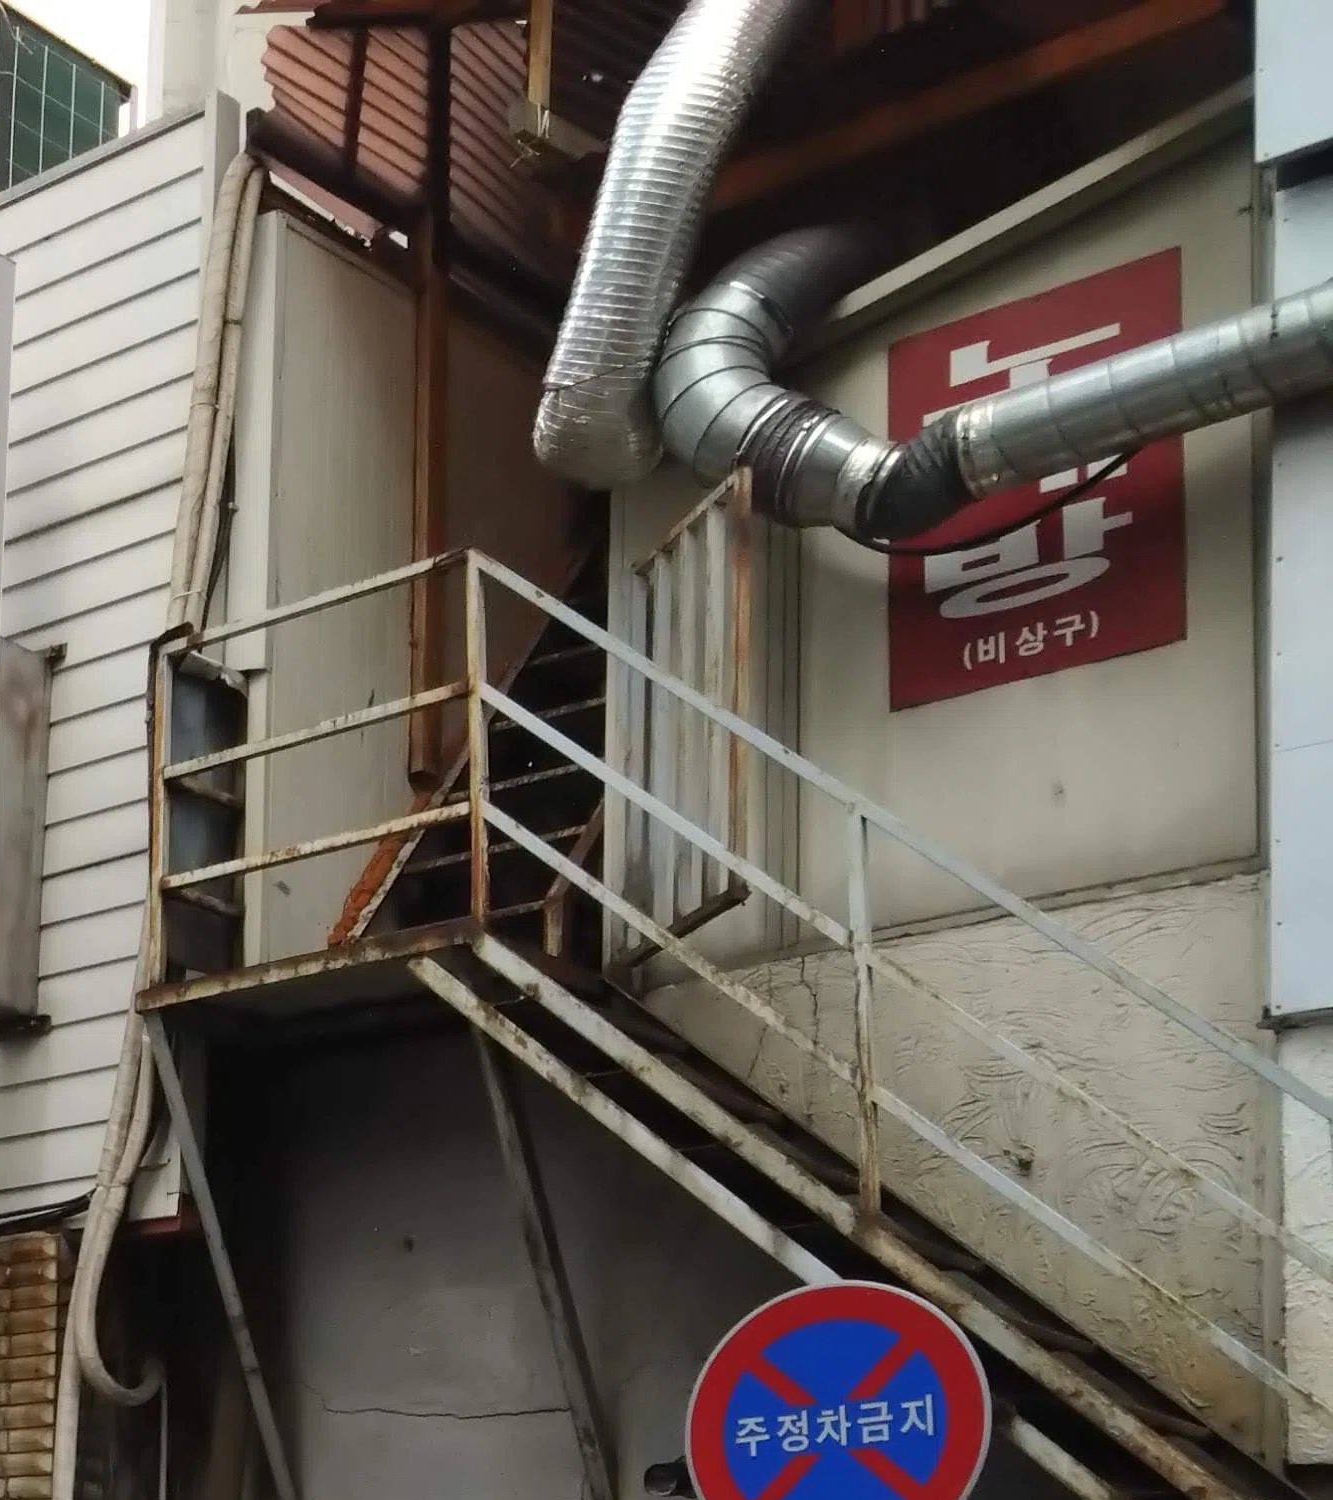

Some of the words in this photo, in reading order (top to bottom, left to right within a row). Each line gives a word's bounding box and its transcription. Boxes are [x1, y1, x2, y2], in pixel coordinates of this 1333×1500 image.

[924, 323, 1132, 619] 노방
[963, 610, 1099, 671] (비상구)
[734, 1392, 935, 1458] 주정차금지
